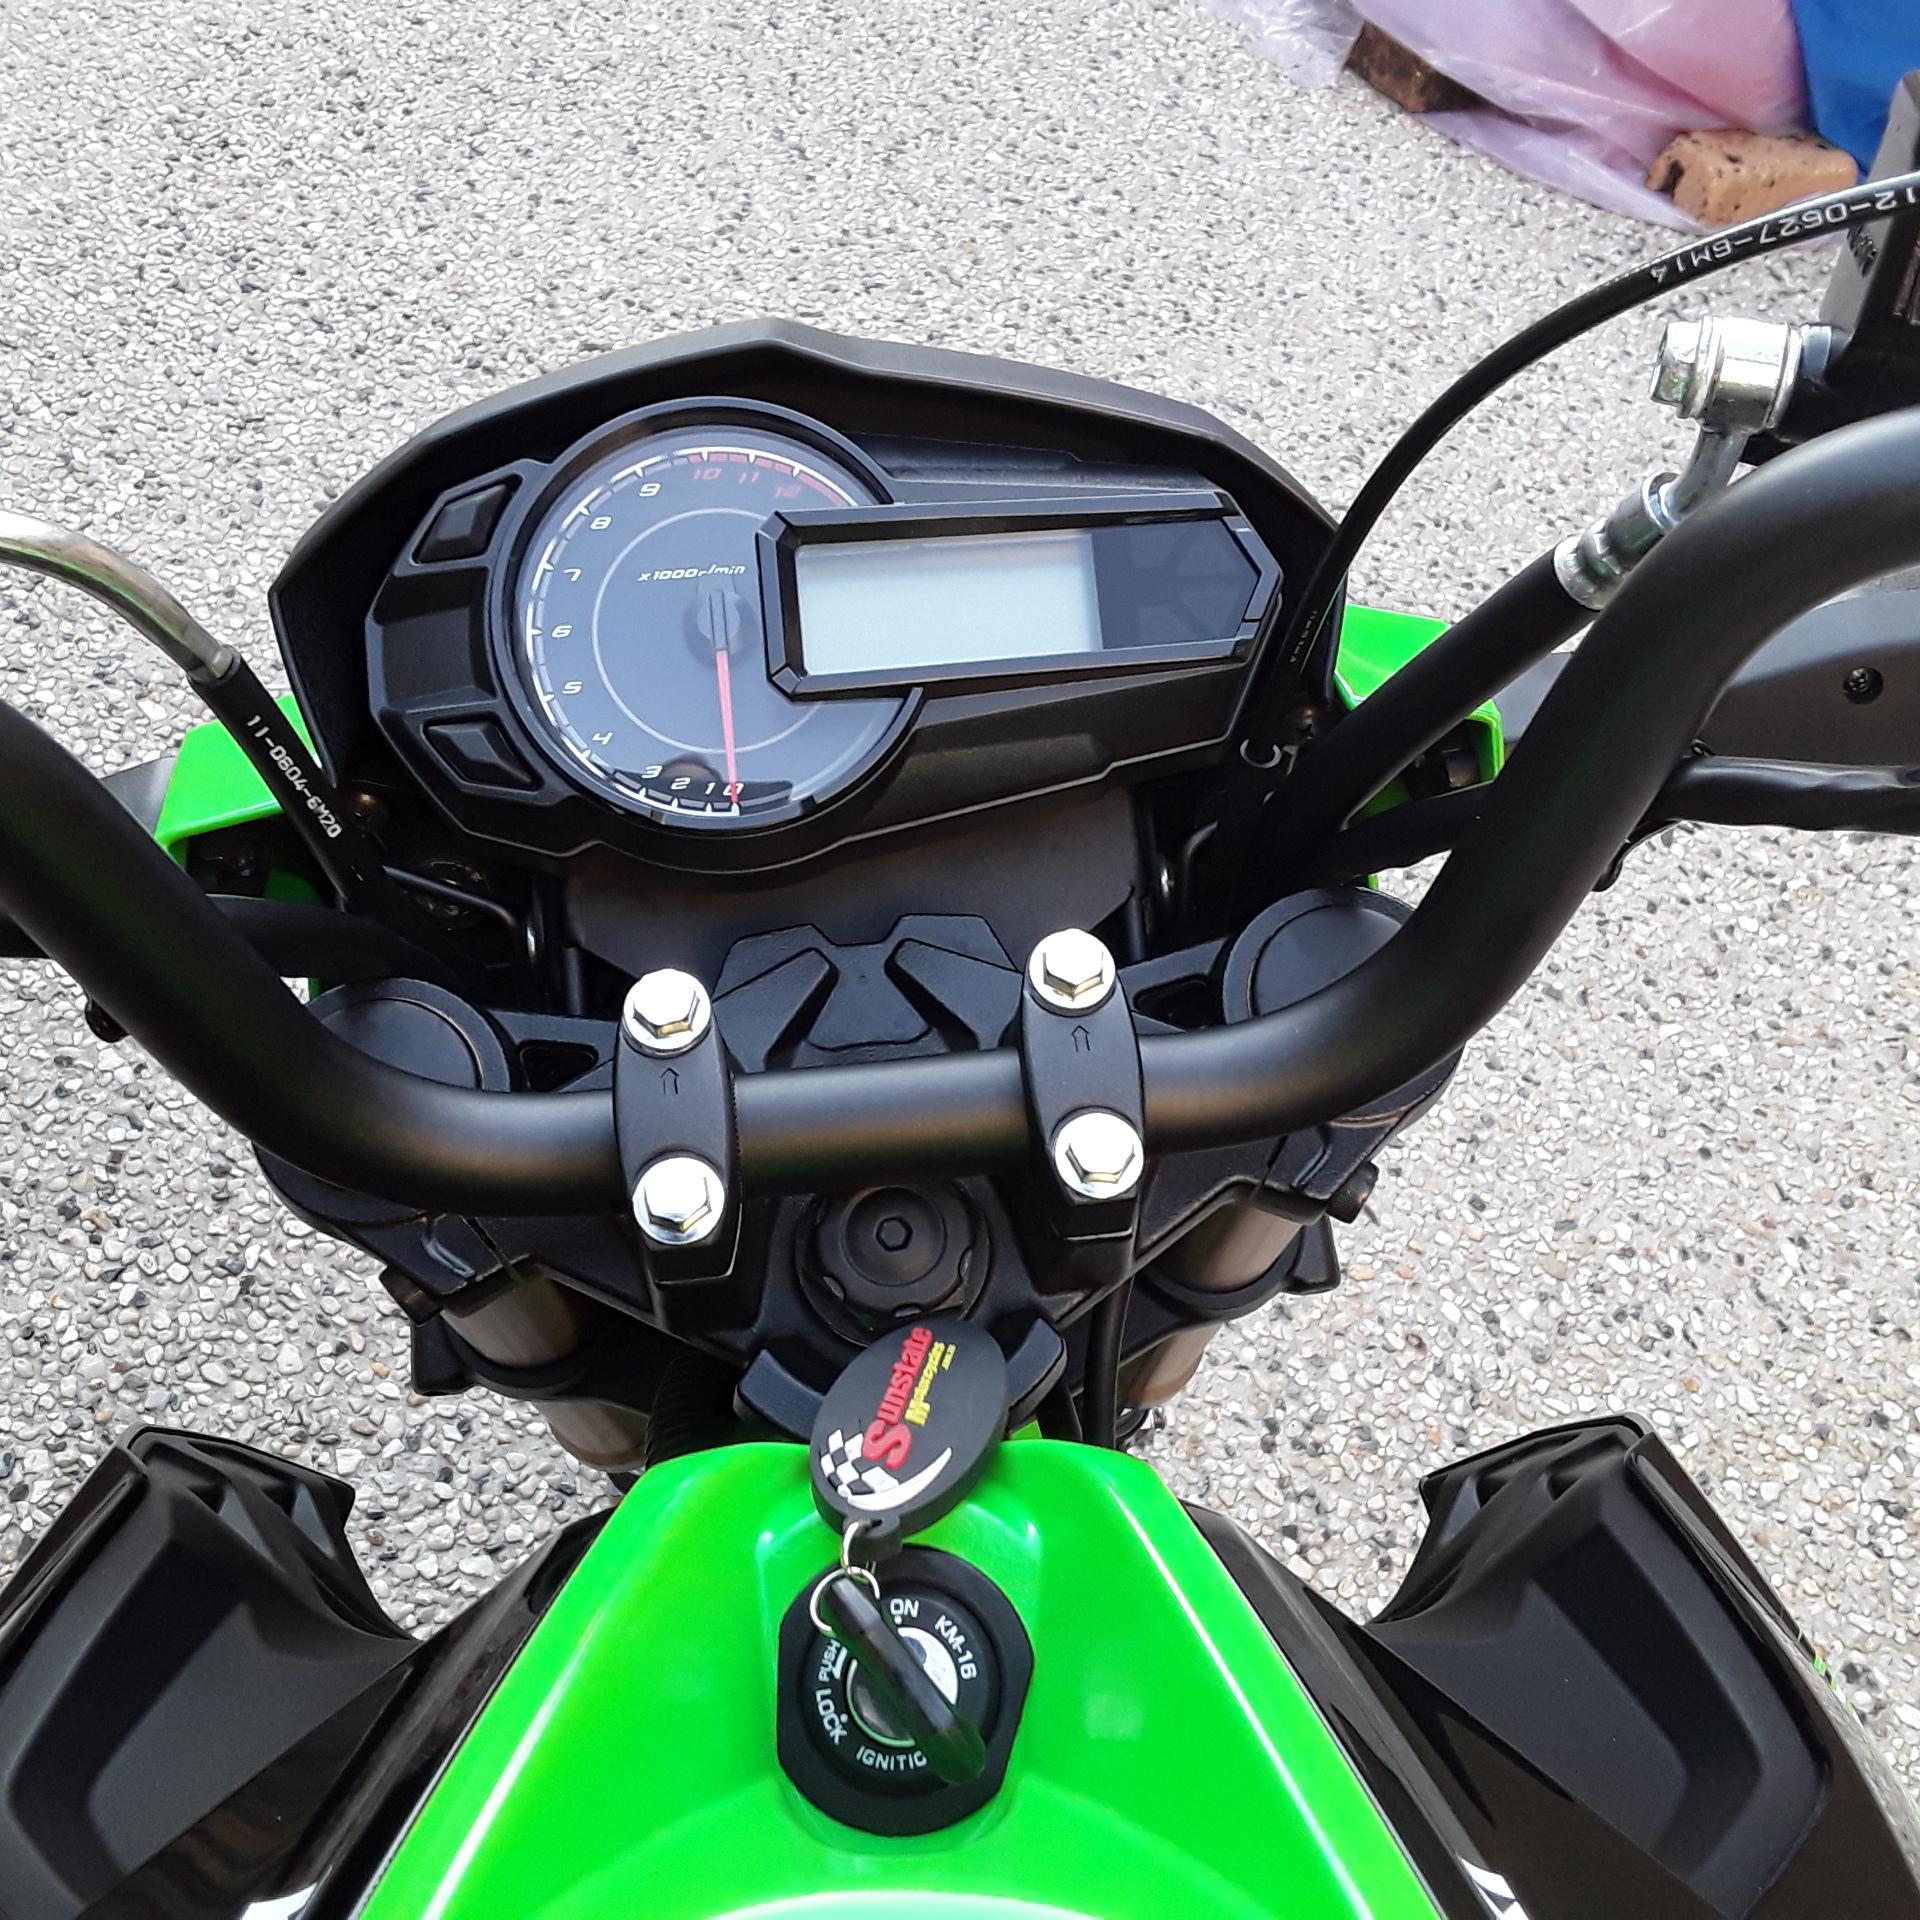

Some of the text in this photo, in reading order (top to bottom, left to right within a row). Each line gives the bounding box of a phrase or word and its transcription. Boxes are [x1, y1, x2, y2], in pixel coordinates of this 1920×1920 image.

[693, 468, 722, 480] 10
[738, 472, 760, 484] 11
[638, 483, 661, 498] 9
[590, 516, 612, 530] 8
[563, 568, 582, 582] 7
[551, 625, 572, 638] 6
[563, 681, 583, 694] 5
[592, 731, 613, 745] 4
[641, 765, 662, 779] 3
[670, 777, 691, 790] 2
[705, 782, 716, 795] 1
[722, 783, 744, 796] 0
[862, 1327, 934, 1470] Sunstate
[890, 1599, 919, 1618] ON
[934, 1615, 977, 1680] KM-16
[818, 1639, 841, 1683] PUSH
[815, 1688, 848, 1745] LOCK
[856, 1745, 928, 1771] IGNITIO
